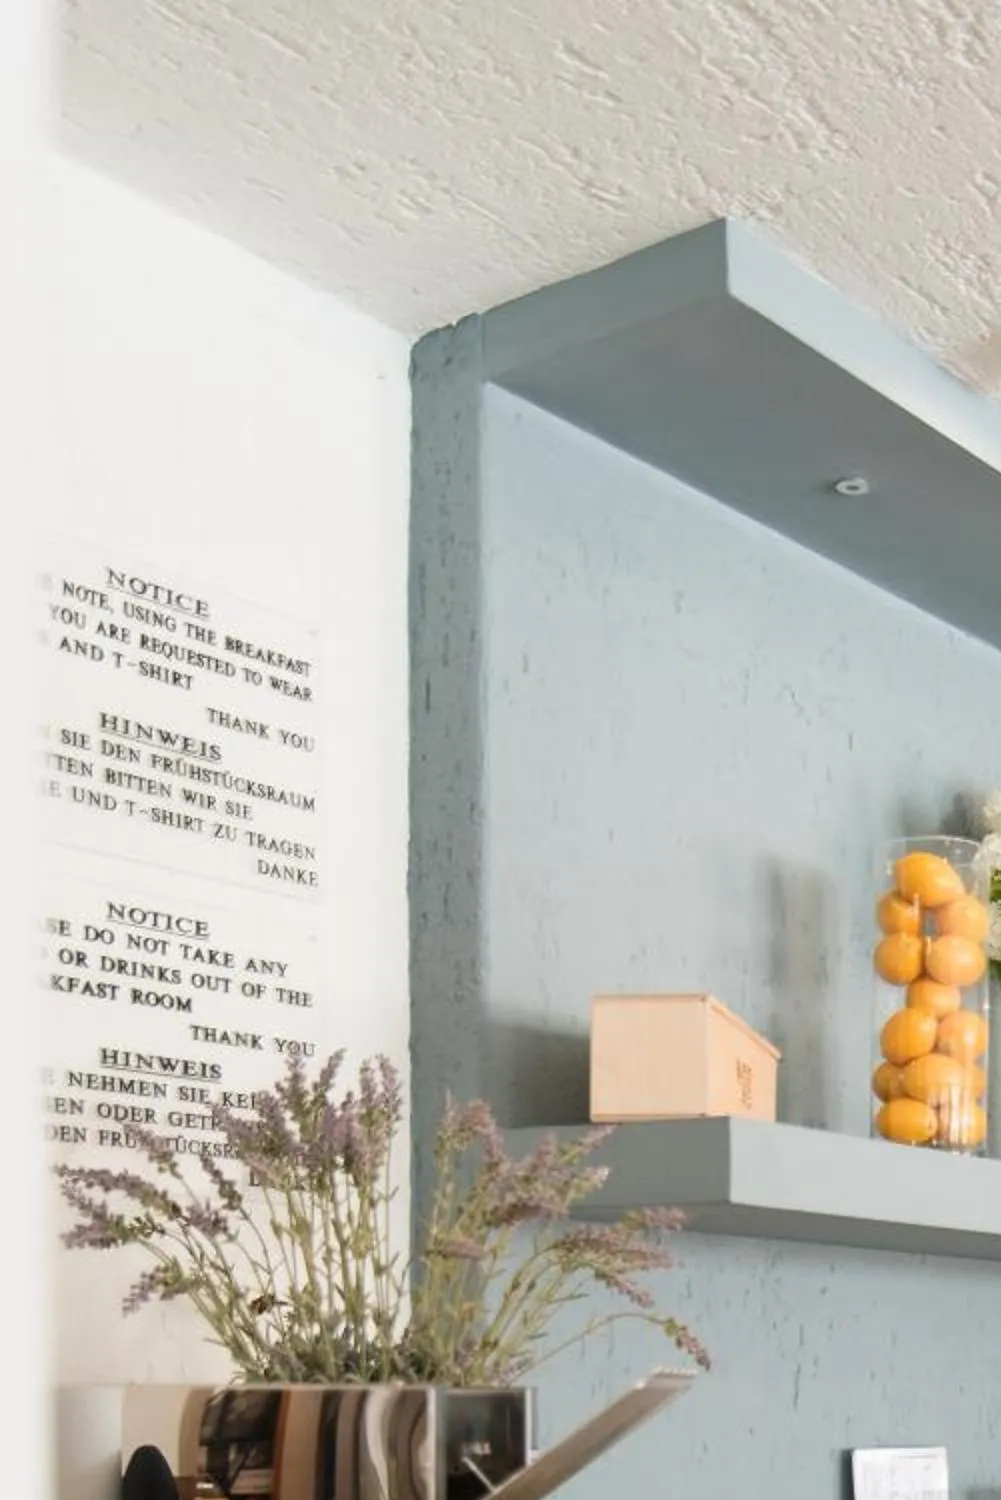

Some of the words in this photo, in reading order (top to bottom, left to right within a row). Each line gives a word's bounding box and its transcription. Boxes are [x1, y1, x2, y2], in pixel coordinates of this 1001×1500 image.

[107, 566, 209, 617] NOTICE
[49, 603, 86, 629] YOU
[96, 621, 130, 645] ARE
[140, 633, 236, 677] REQUESTED
[242, 667, 262, 687] TO
[270, 676, 312, 700] WEAR
[59, 636, 104, 662] AND
[112, 652, 193, 690] T-SHIRT
[123, 601, 177, 632] USING
[184, 621, 217, 646] THE
[225, 635, 311, 678] BREAKFAST
[100, 712, 221, 760] HINWEIS
[207, 707, 269, 739] THANK
[279, 729, 315, 752] YOU
[61, 728, 91, 750] SIE
[101, 740, 140, 763] DEN
[151, 753, 315, 812] FRÜHSTÜCKSRAUM
[105, 768, 172, 798] BITTEN
[181, 788, 216, 810] WIR
[226, 800, 252, 820] SIE
[72, 786, 116, 811] UND
[126, 800, 204, 832] T-SHIRT
[214, 823, 237, 841] ZU
[246, 831, 316, 859] TRAGEN
[257, 859, 318, 887] DANKE
[107, 901, 209, 937] NOTICE
[84, 925, 114, 945] DO
[127, 933, 169, 956] NOT
[180, 944, 234, 968] TAKE
[246, 958, 288, 977] ANY
[46, 973, 119, 1000] KFAST
[131, 988, 192, 1012] ROOM
[58, 948, 88, 968] OR
[100, 955, 181, 984] DRINKS
[191, 973, 231, 993] OUT
[241, 981, 266, 999] OF
[275, 988, 312, 1007] THE
[100, 1048, 222, 1078] HINWEIS
[190, 1025, 263, 1050] THANK
[275, 1038, 315, 1057] YOU
[68, 1071, 167, 1097] NEHMEN
[178, 1086, 210, 1104] SIE
[222, 1091, 255, 1109] KEI
[97, 1103, 157, 1124] ODER
